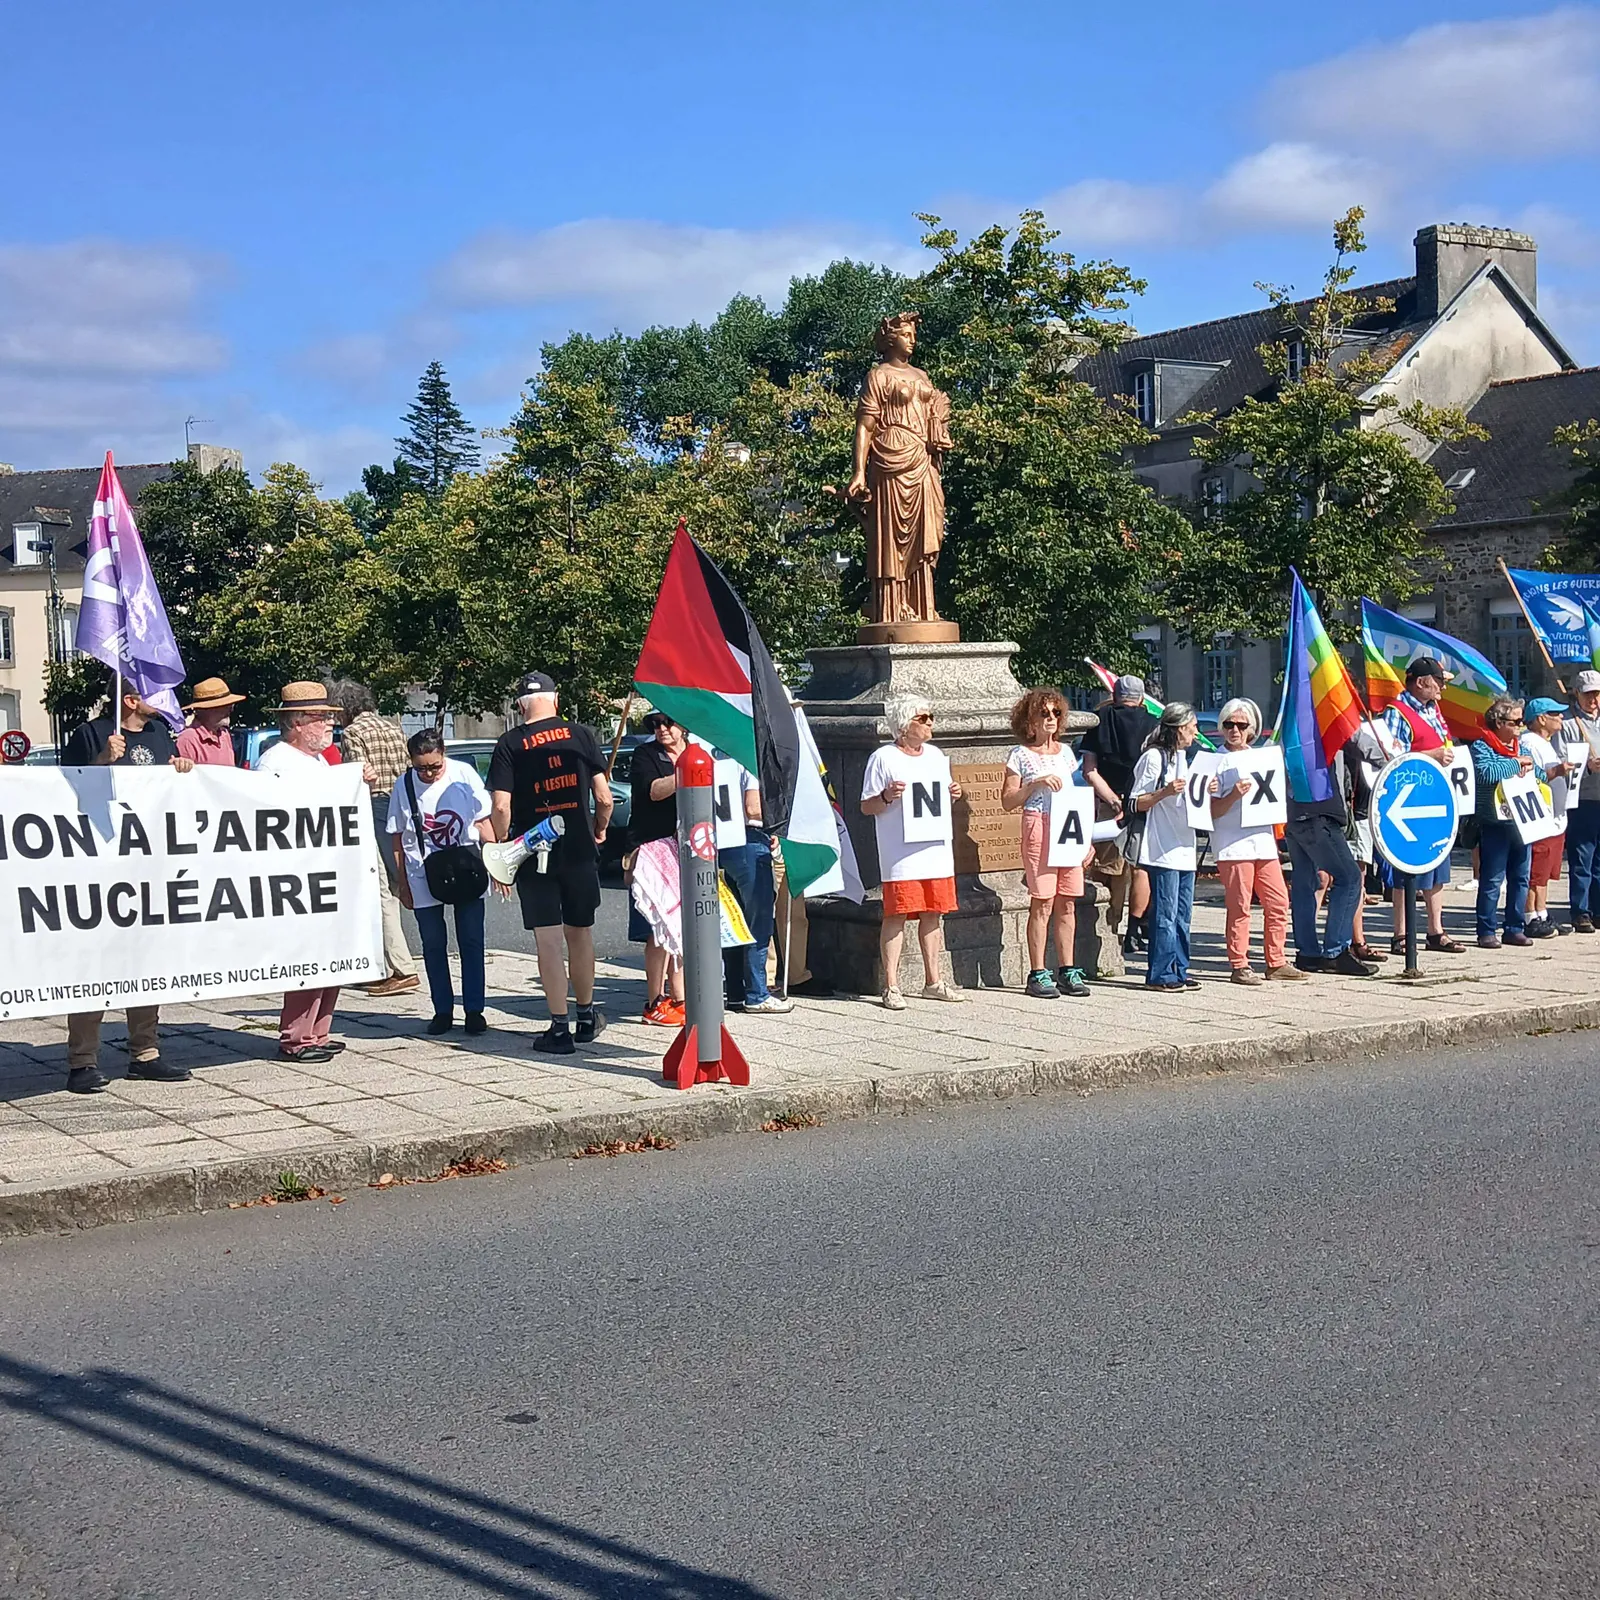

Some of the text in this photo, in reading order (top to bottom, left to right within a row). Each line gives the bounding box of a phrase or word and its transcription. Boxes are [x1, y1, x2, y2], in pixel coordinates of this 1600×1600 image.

[1552, 581, 1568, 590] LES
[534, 773, 578, 794] PLESTIN
[1189, 774, 1208, 808] U
[1250, 770, 1278, 805] X
[1451, 767, 1469, 796] R
[912, 781, 942, 818] N
[1512, 791, 1545, 824] M
[118, 802, 153, 856] À
[165, 806, 361, 854] L'ARME
[1057, 811, 1084, 845] A
[18, 869, 339, 933] NUCLÉAIRE
[695, 900, 720, 916] BOM
[0, 989, 36, 1005] OUR
[38, 979, 139, 1002] L'INTERDICTION
[142, 977, 167, 992] DES
[171, 971, 223, 989] ARMES
[228, 963, 319, 984] NUCLÉAIRES
[330, 959, 353, 973] CIAN
[355, 957, 370, 970] 29
